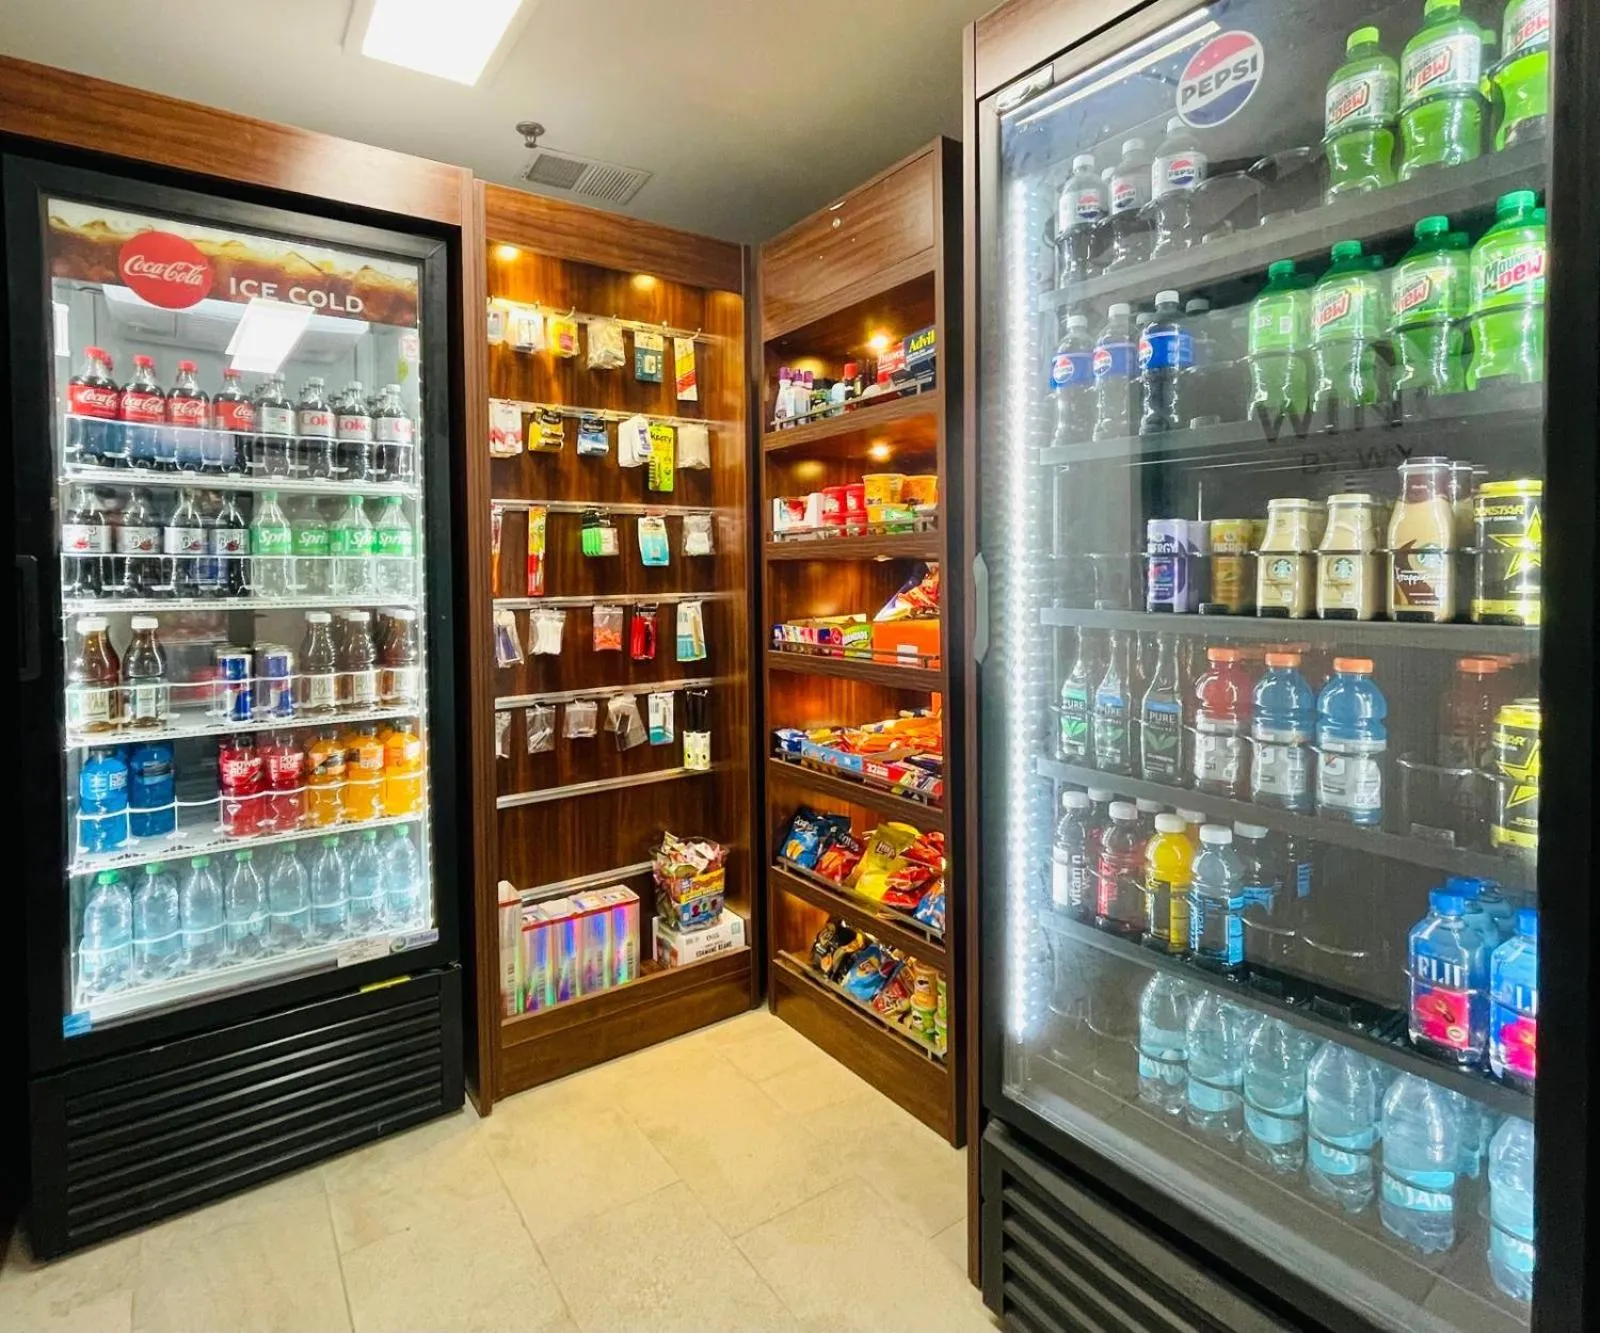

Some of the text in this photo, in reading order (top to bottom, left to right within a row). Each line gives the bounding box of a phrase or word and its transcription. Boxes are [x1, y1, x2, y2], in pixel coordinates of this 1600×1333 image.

[1181, 53, 1258, 107] PEPSI
[123, 254, 208, 286] Coca-Cola
[229, 276, 365, 314] ICE COLD
[908, 329, 936, 353] Advil
[1070, 854, 1082, 907] vitamn
